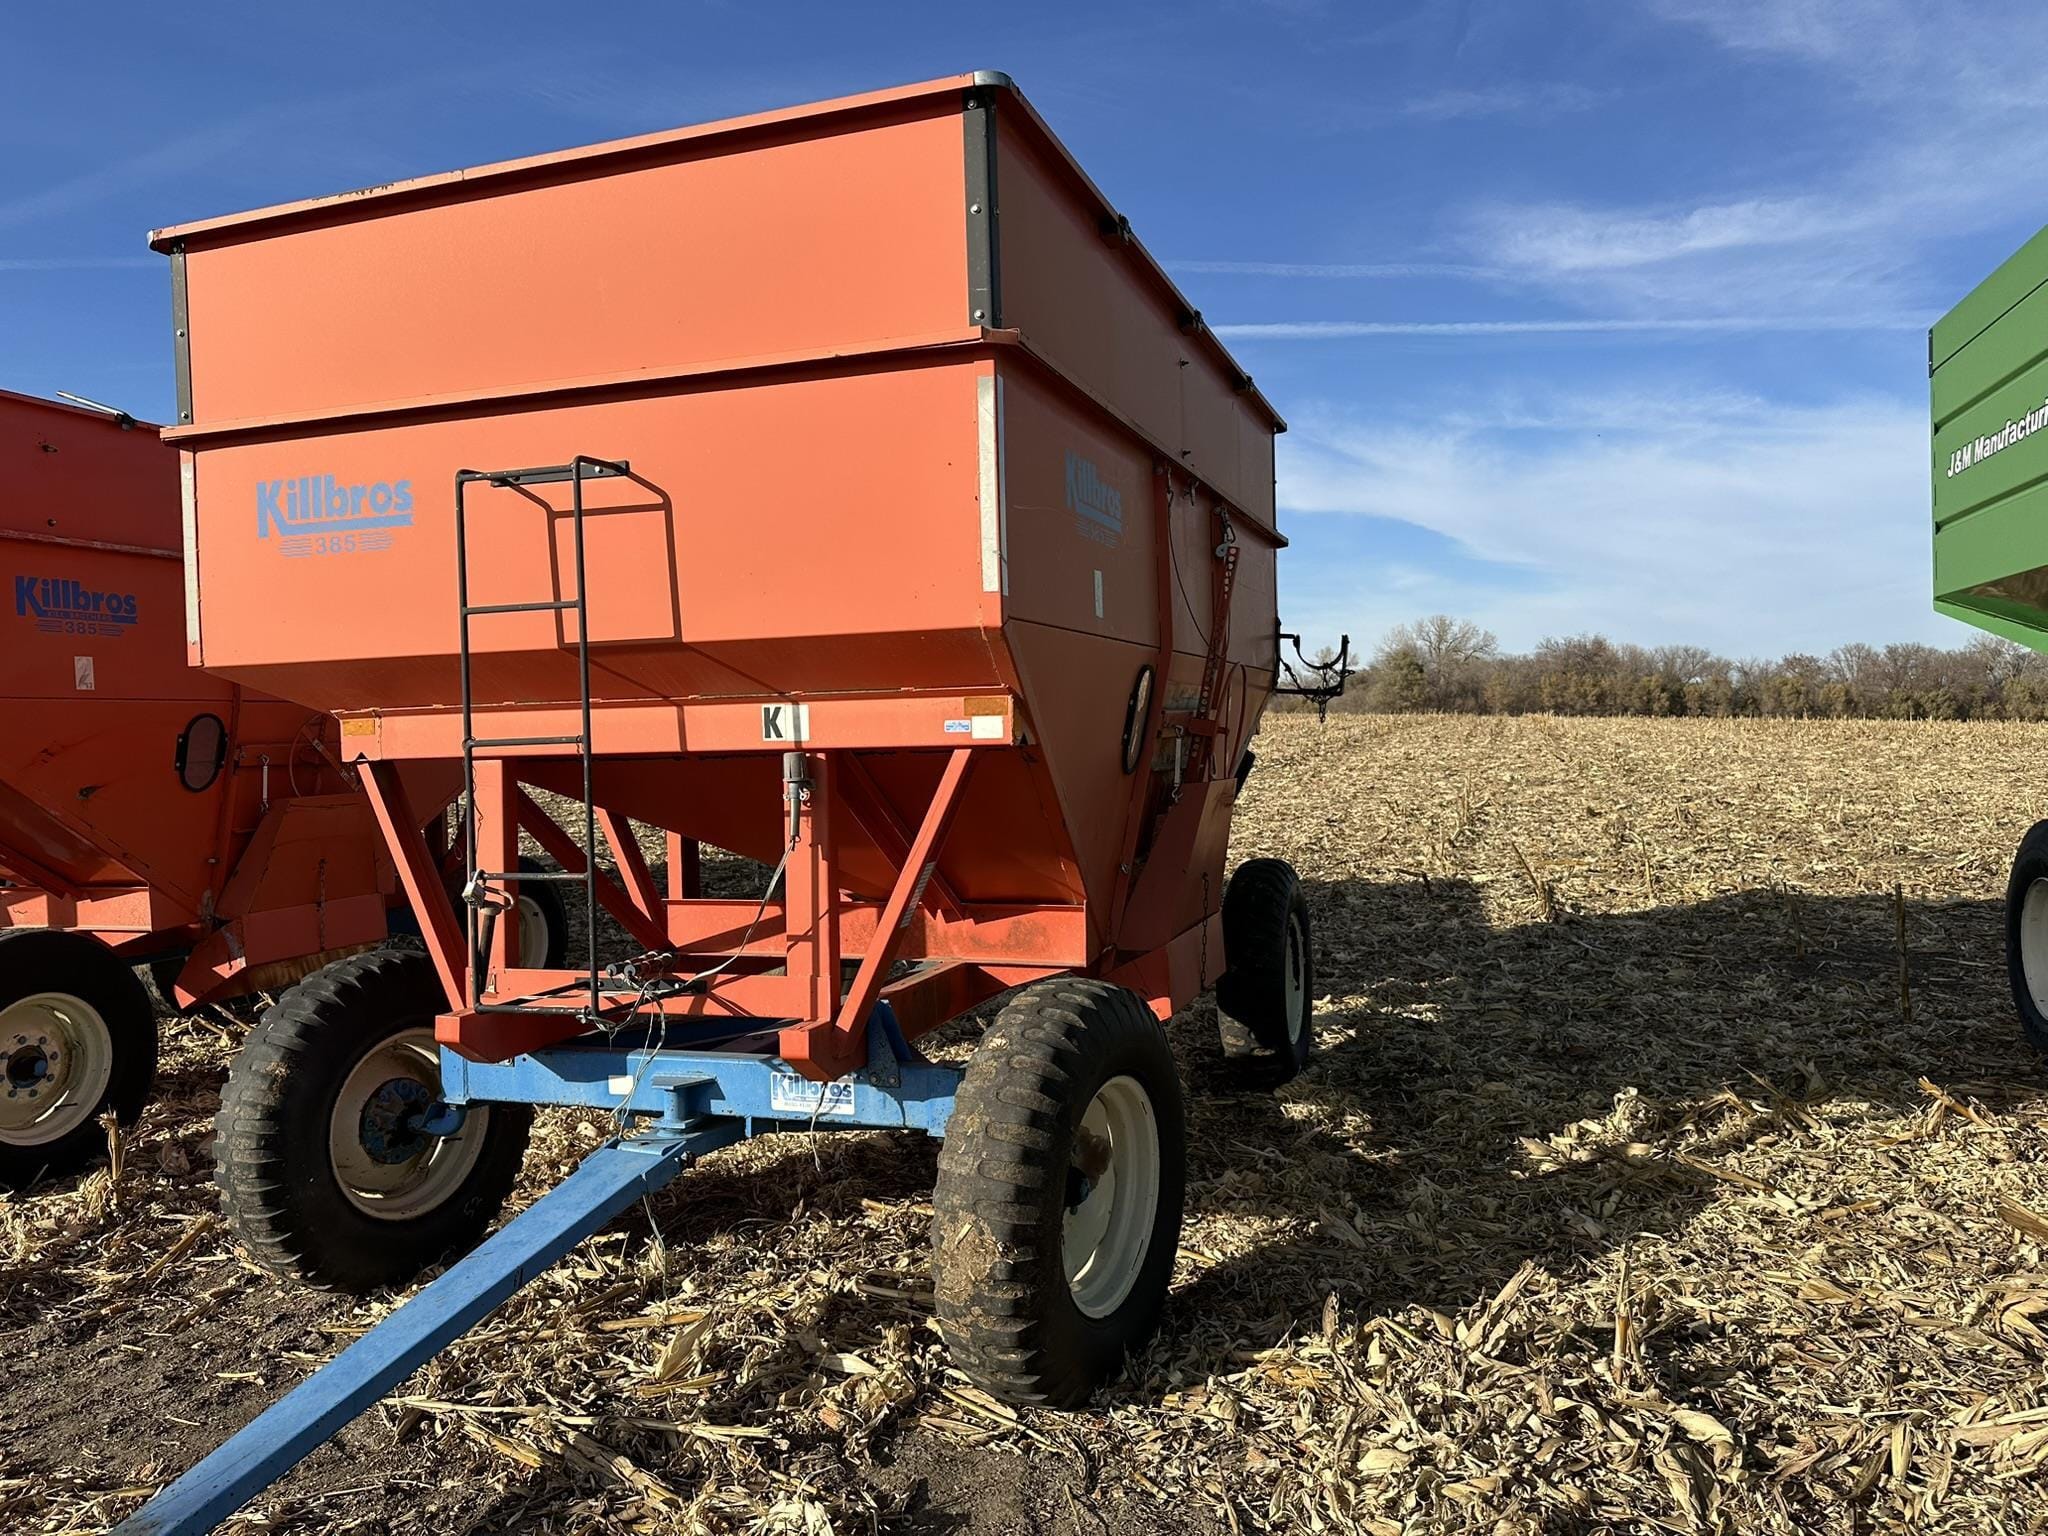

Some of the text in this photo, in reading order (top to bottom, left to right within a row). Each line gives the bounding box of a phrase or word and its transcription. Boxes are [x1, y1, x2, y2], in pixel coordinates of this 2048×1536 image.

[1946, 441, 1972, 478] J&M
[1063, 447, 1121, 520] Killbros
[256, 473, 414, 539] Killbros
[315, 534, 357, 556] 385
[15, 575, 138, 617] Killbros
[64, 621, 97, 635] 385
[763, 706, 784, 739] K
